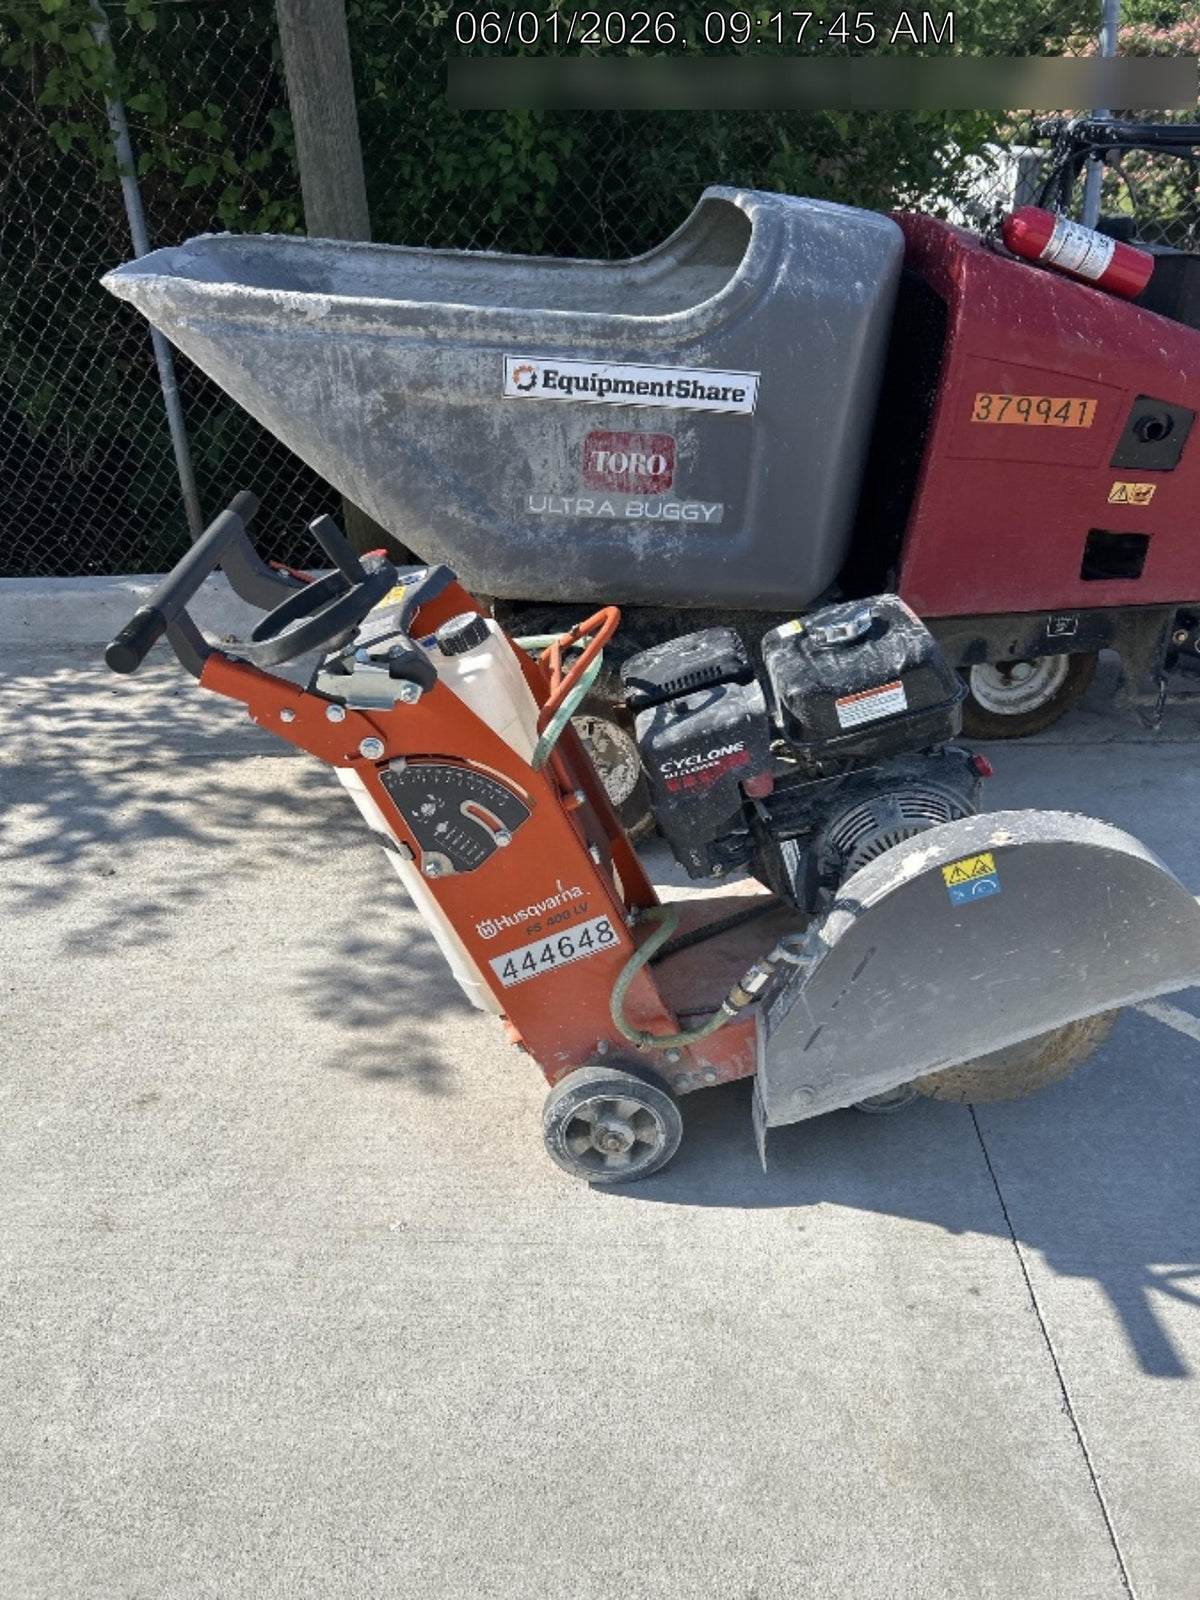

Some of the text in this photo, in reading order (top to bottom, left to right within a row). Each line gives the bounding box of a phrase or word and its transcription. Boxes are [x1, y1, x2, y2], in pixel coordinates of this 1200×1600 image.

[541, 369, 746, 403] EquipmentShare
[975, 395, 1089, 425] 379941
[591, 450, 668, 476] TORO
[528, 495, 719, 521] ULTRA BUGGY
[659, 740, 745, 773] CYCLONE
[494, 880, 584, 931] Husqvarna
[525, 901, 589, 936] FS 400 LV
[502, 919, 615, 979] 444648
